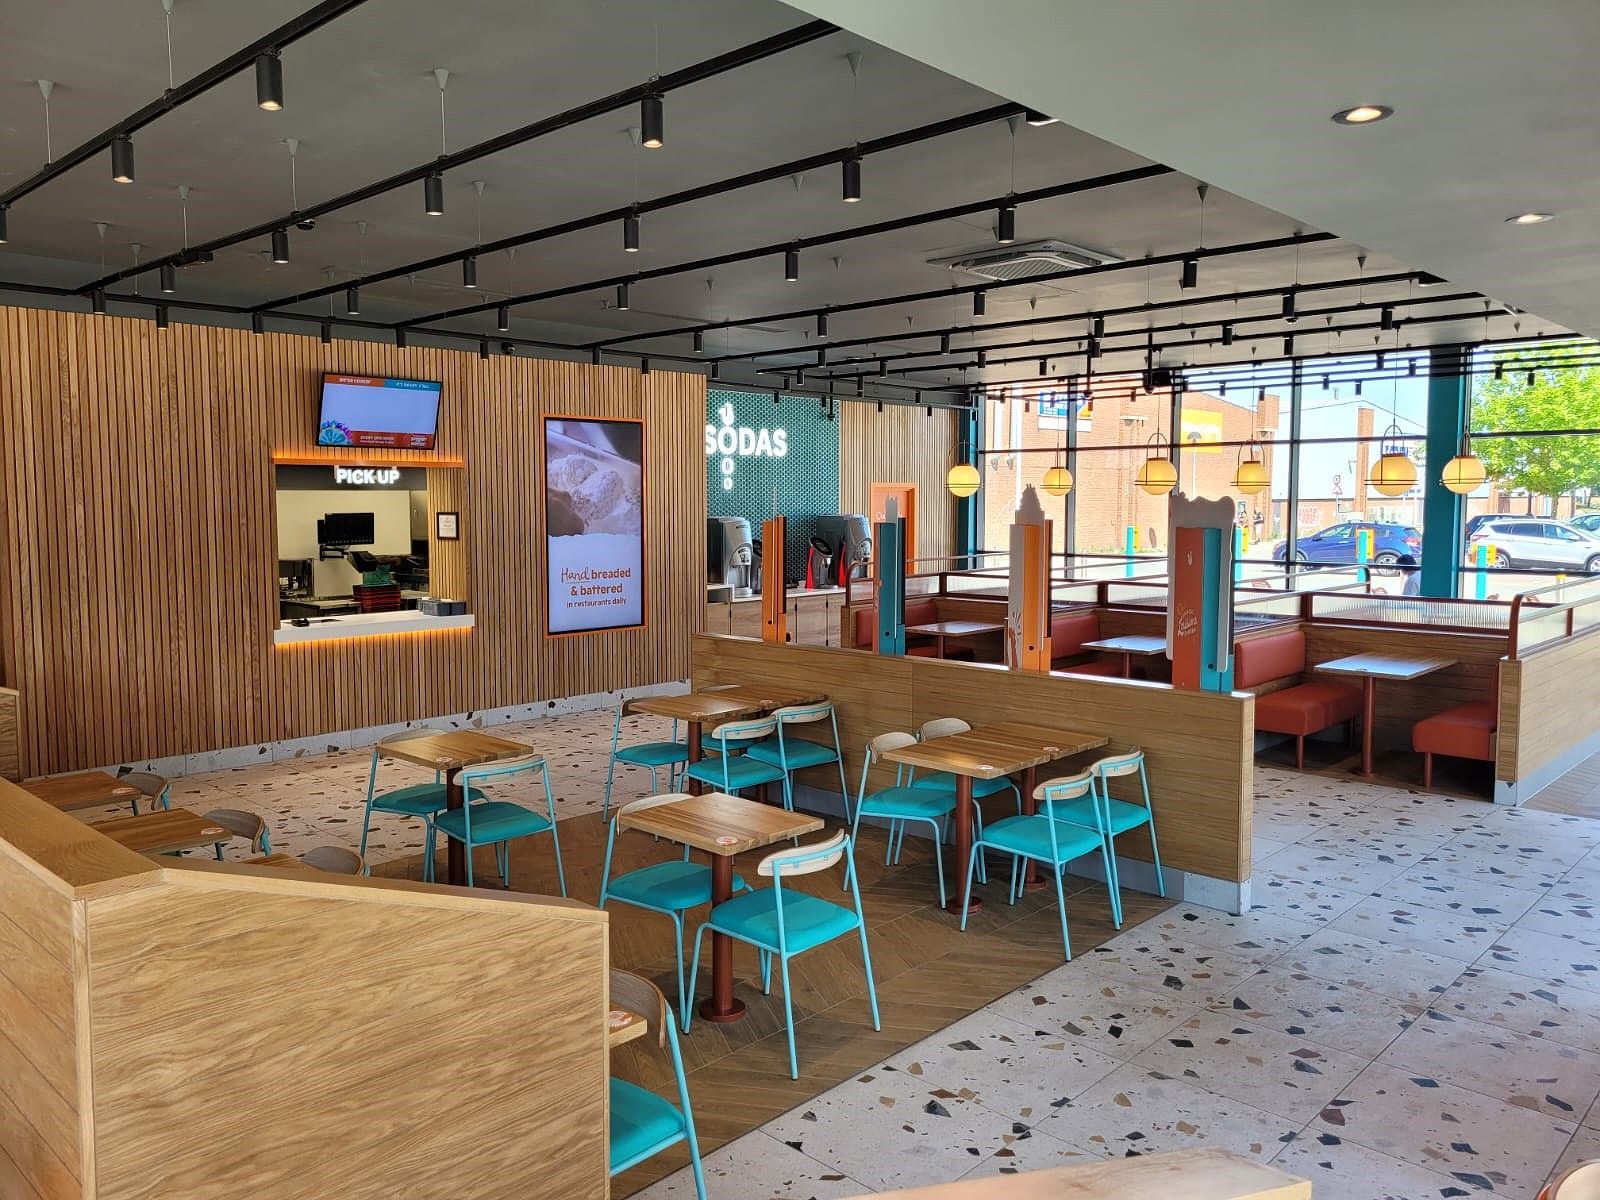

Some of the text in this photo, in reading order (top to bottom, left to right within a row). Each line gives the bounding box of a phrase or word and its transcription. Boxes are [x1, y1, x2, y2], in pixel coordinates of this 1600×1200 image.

[705, 425, 788, 457] SODAS
[336, 469, 400, 485] PICK UP
[561, 566, 631, 584] Hand breaded
[570, 583, 623, 596] & battered
[566, 597, 627, 608] in restaurants daily
